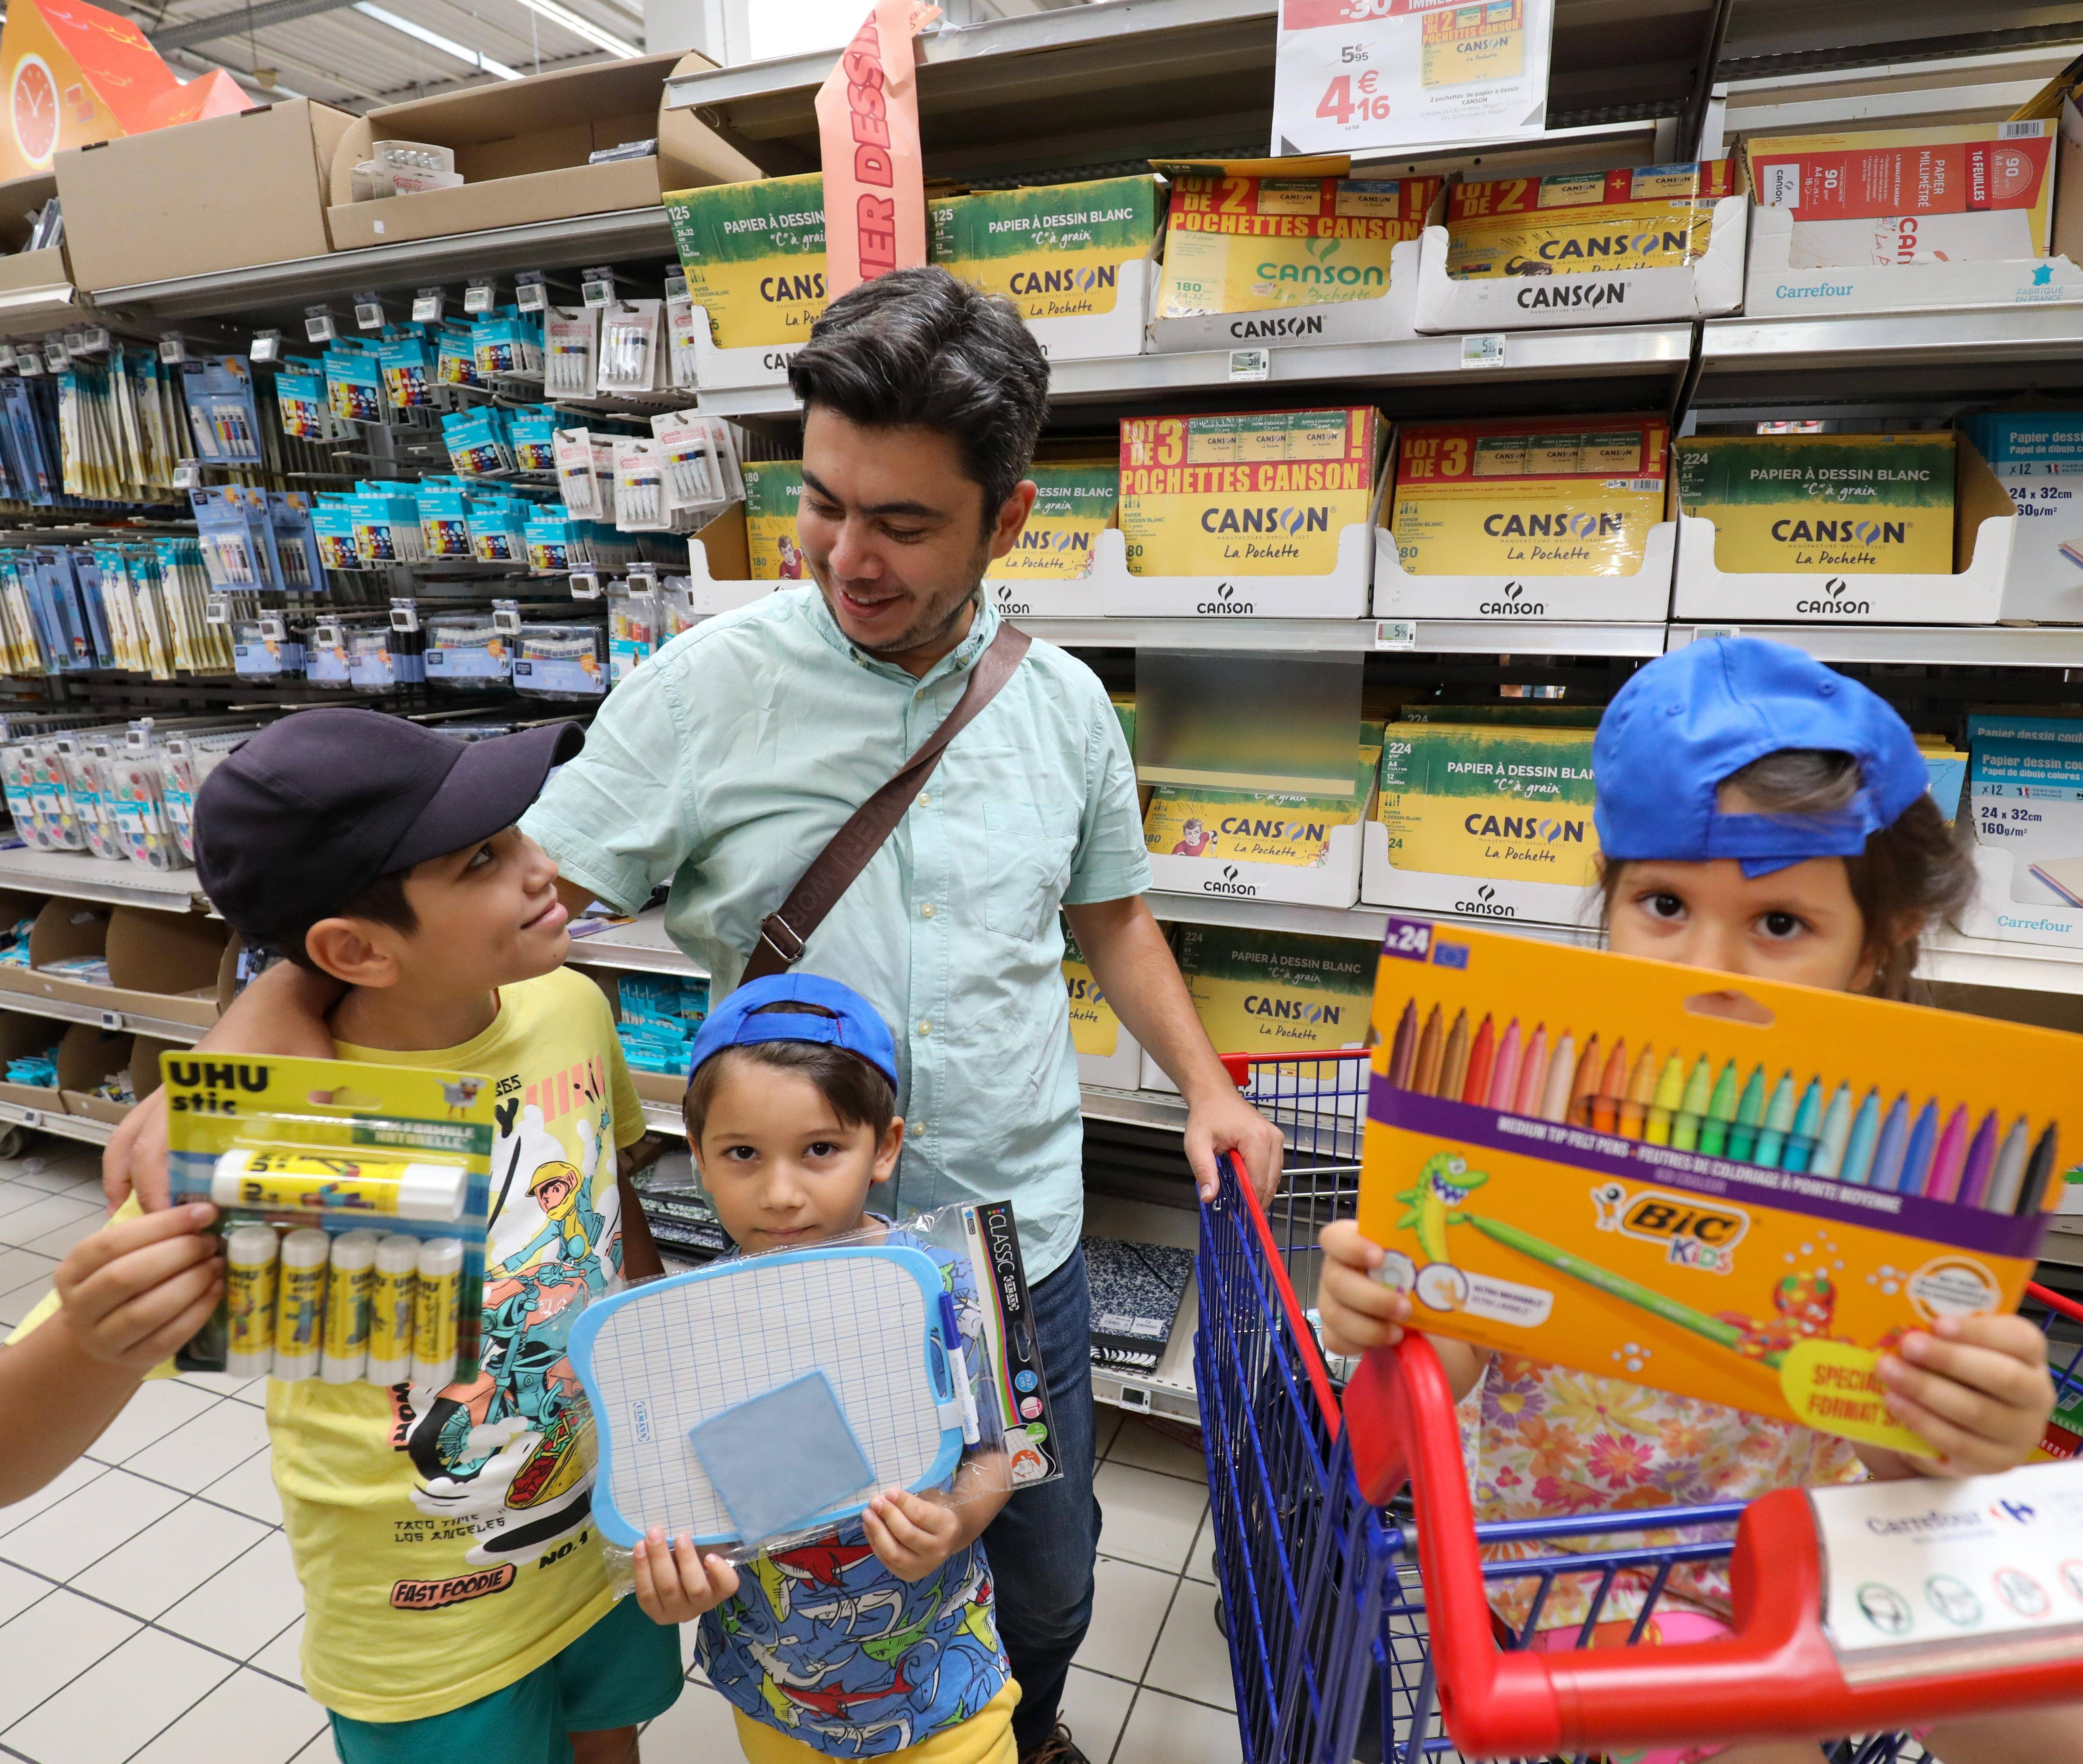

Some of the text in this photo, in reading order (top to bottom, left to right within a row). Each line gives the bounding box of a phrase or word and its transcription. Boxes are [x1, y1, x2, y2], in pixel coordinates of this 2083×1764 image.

[1423, 19, 1519, 45] POCHETTES CANSON
[1456, 36, 1509, 53] CANSON
[1435, 93, 1464, 102] pochettes
[1475, 90, 1493, 98] papier
[2005, 157, 2019, 177] 90
[1918, 151, 1931, 208] MILLIMÉTRÉ
[1933, 160, 1945, 195] PAPIER
[1973, 162, 1985, 201] FEUILLES
[1455, 181, 1493, 201] LOT
[1184, 194, 1212, 212] DE
[668, 206, 690, 220] 125
[932, 209, 953, 222] 125
[989, 208, 1133, 233] PAPIER DESSIN BLANC
[724, 210, 825, 234] PAPIER À DESSIN
[1170, 212, 1309, 237] POCHETTES
[791, 232, 799, 245] à
[1060, 230, 1091, 248] grain
[1539, 230, 1687, 260] CANSON
[1010, 264, 1115, 295] CANSON
[1256, 262, 1383, 285] CANSON
[760, 273, 828, 302] CANS
[1176, 282, 1201, 292] 180
[1306, 287, 1370, 300] Pochette
[1517, 282, 1624, 309] CANSON
[1776, 283, 1853, 299] Carrefour
[2016, 287, 2063, 296] FABRIQUÉ
[1030, 299, 1092, 316] La Pochette
[786, 313, 799, 326] La
[1230, 315, 1322, 339] CANSON
[1124, 418, 1182, 465] LOT 3
[2010, 432, 2049, 444] Papier
[1404, 438, 1468, 476] LOT 3
[1683, 453, 1708, 464] 224
[2010, 446, 2033, 455] Papel
[1411, 459, 1435, 477] DE
[1751, 469, 1930, 481] PAPIER DESSIN BLANC
[744, 472, 759, 482] 180
[1121, 463, 1359, 494] POCHETTES CANSON
[1074, 487, 1113, 497] BLANC
[1838, 485, 1876, 500] grain
[2010, 487, 2072, 499] 24 32cm
[1043, 502, 1072, 514] grain
[1201, 506, 1328, 536] CANSON
[1484, 511, 1622, 540] CANSON
[1771, 519, 1905, 546] CANSON
[1224, 544, 1300, 559] La Pochette
[1507, 546, 1591, 560] La Pochette
[1796, 550, 1876, 565] La Pochette
[1022, 557, 1064, 569] Pochette
[1390, 743, 1411, 754] 224
[1447, 762, 1557, 778] PAPIER DESSIN
[1983, 754, 2061, 770] Papier dessin
[1983, 766, 2080, 780] Papel dibujo colores
[1525, 782, 1560, 798] grain
[1981, 807, 2042, 822] 24 32cm
[1221, 817, 1325, 843] CANSON
[1465, 813, 1584, 845] CANSON
[1234, 843, 1296, 857] La Pochette
[1485, 846, 1556, 862] La Pochette
[1998, 916, 2072, 933] Carrefour
[1185, 931, 1203, 943] 224
[1386, 926, 1430, 954] x24
[1232, 951, 1361, 973] PAPIER DESSIN BLANC
[1294, 972, 1322, 983] grain
[1244, 995, 1340, 1026] CANSON
[1260, 1024, 1317, 1040] La Pochette
[169, 1062, 268, 1092] UHU
[172, 1093, 236, 1115] stic
[1497, 1115, 1903, 1214] MEDIUM TIP FELT PENS FEUTRES DE COLORIAGE POINTE MOYENNE
[1005, 1277, 1017, 1308] ULMANN
[1020, 1377, 1025, 1387] cm
[636, 1403, 647, 1442] ULMANN
[394, 1520, 435, 1530] TACO
[395, 1517, 505, 1542] LOS ANGELES
[1867, 1510, 1981, 1536] Carrefour
[395, 1569, 504, 1603] FAST FOODIE
